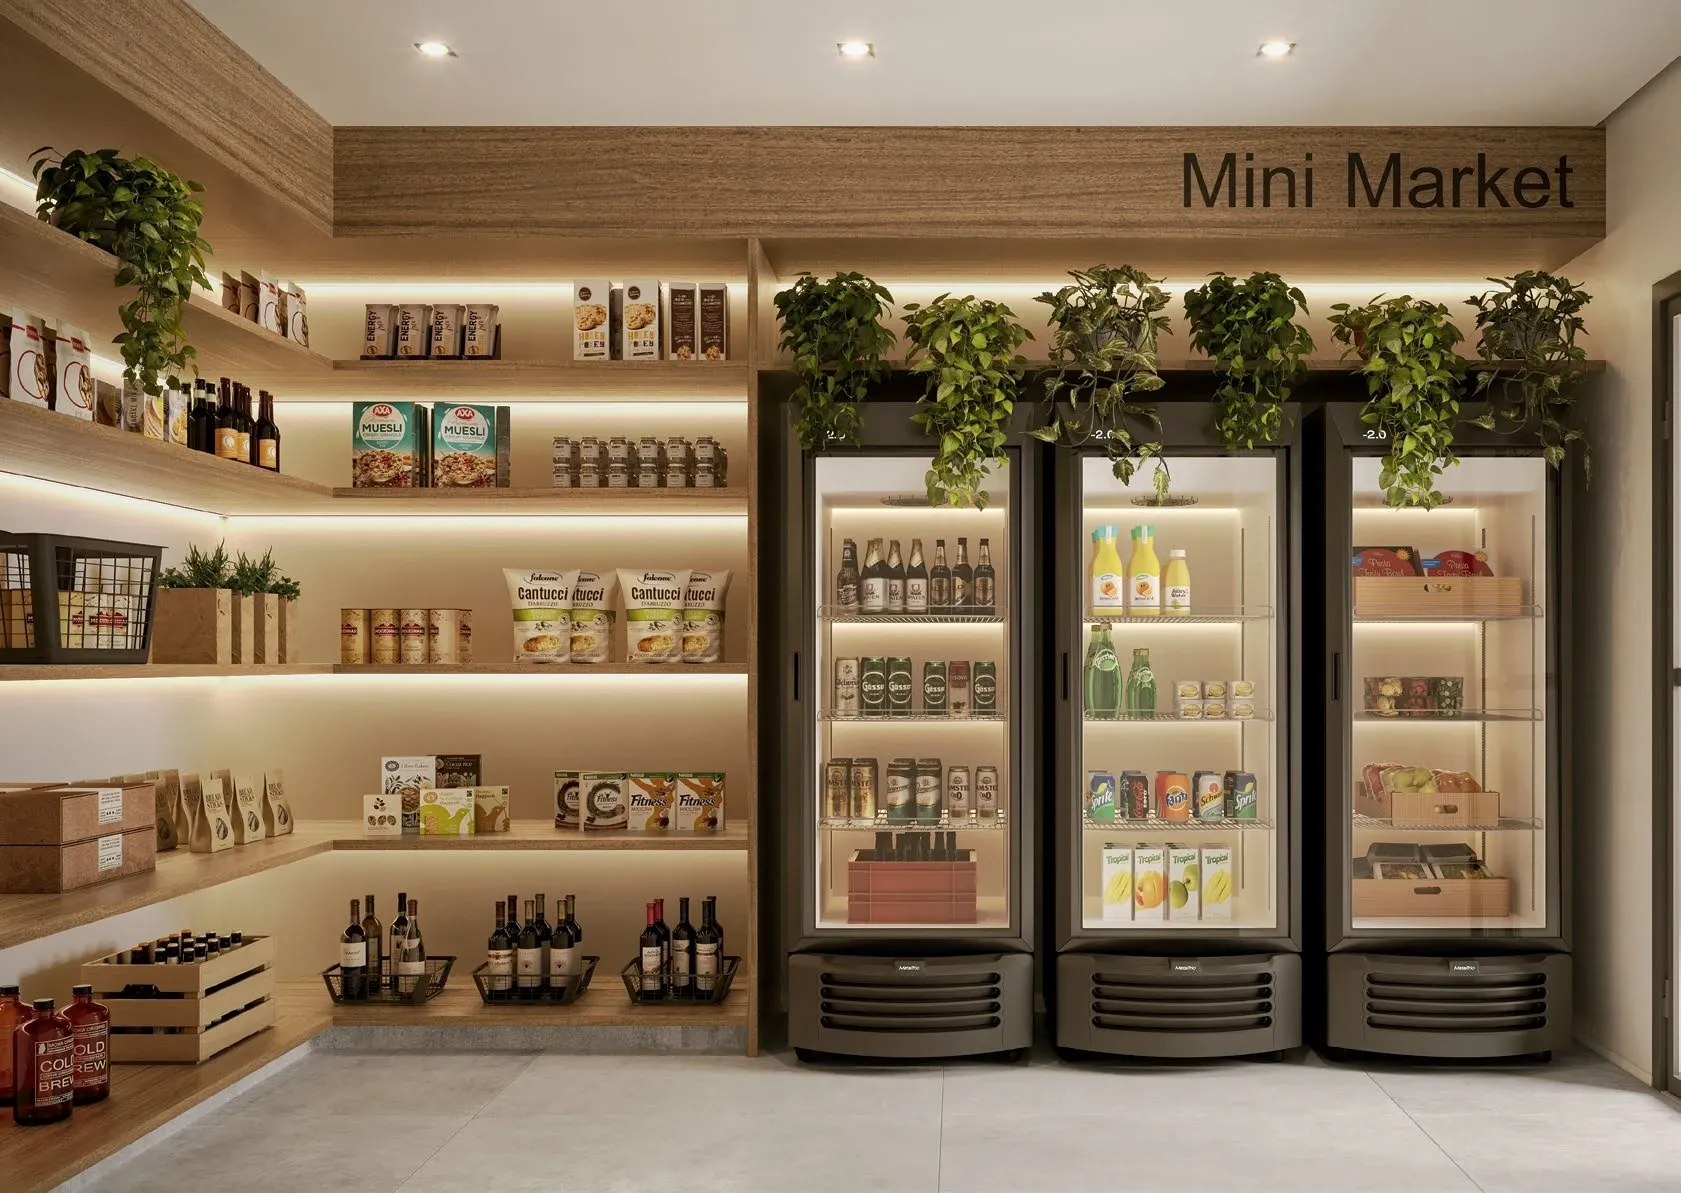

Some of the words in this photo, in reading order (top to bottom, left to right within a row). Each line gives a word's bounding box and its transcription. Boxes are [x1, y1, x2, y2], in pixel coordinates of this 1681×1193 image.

[1183, 152, 1313, 208] Mini
[1347, 152, 1574, 209] Market
[366, 310, 377, 342] ENERGY
[400, 310, 411, 342] ENERGY
[434, 310, 445, 342] ENERGY
[467, 310, 478, 342] ENERGY
[374, 406, 391, 416] AXA
[457, 408, 474, 418] AXA
[362, 423, 402, 433] MUESLI
[444, 426, 486, 437] MUESLI
[1362, 429, 1387, 439] -2.0
[518, 586, 569, 601] Cantucci
[631, 586, 681, 601] Cantucci
[630, 794, 668, 807] Fitness
[679, 794, 716, 807] Fitness
[1091, 789, 1113, 811] Sprite
[1165, 792, 1188, 807] Fanta
[1106, 853, 1129, 864] Tropical
[1137, 853, 1161, 864] Tropical
[1172, 853, 1196, 864] Tropical
[1205, 853, 1229, 864] Tropical
[74, 1041, 105, 1057] OLD
[74, 1059, 107, 1074] REW
